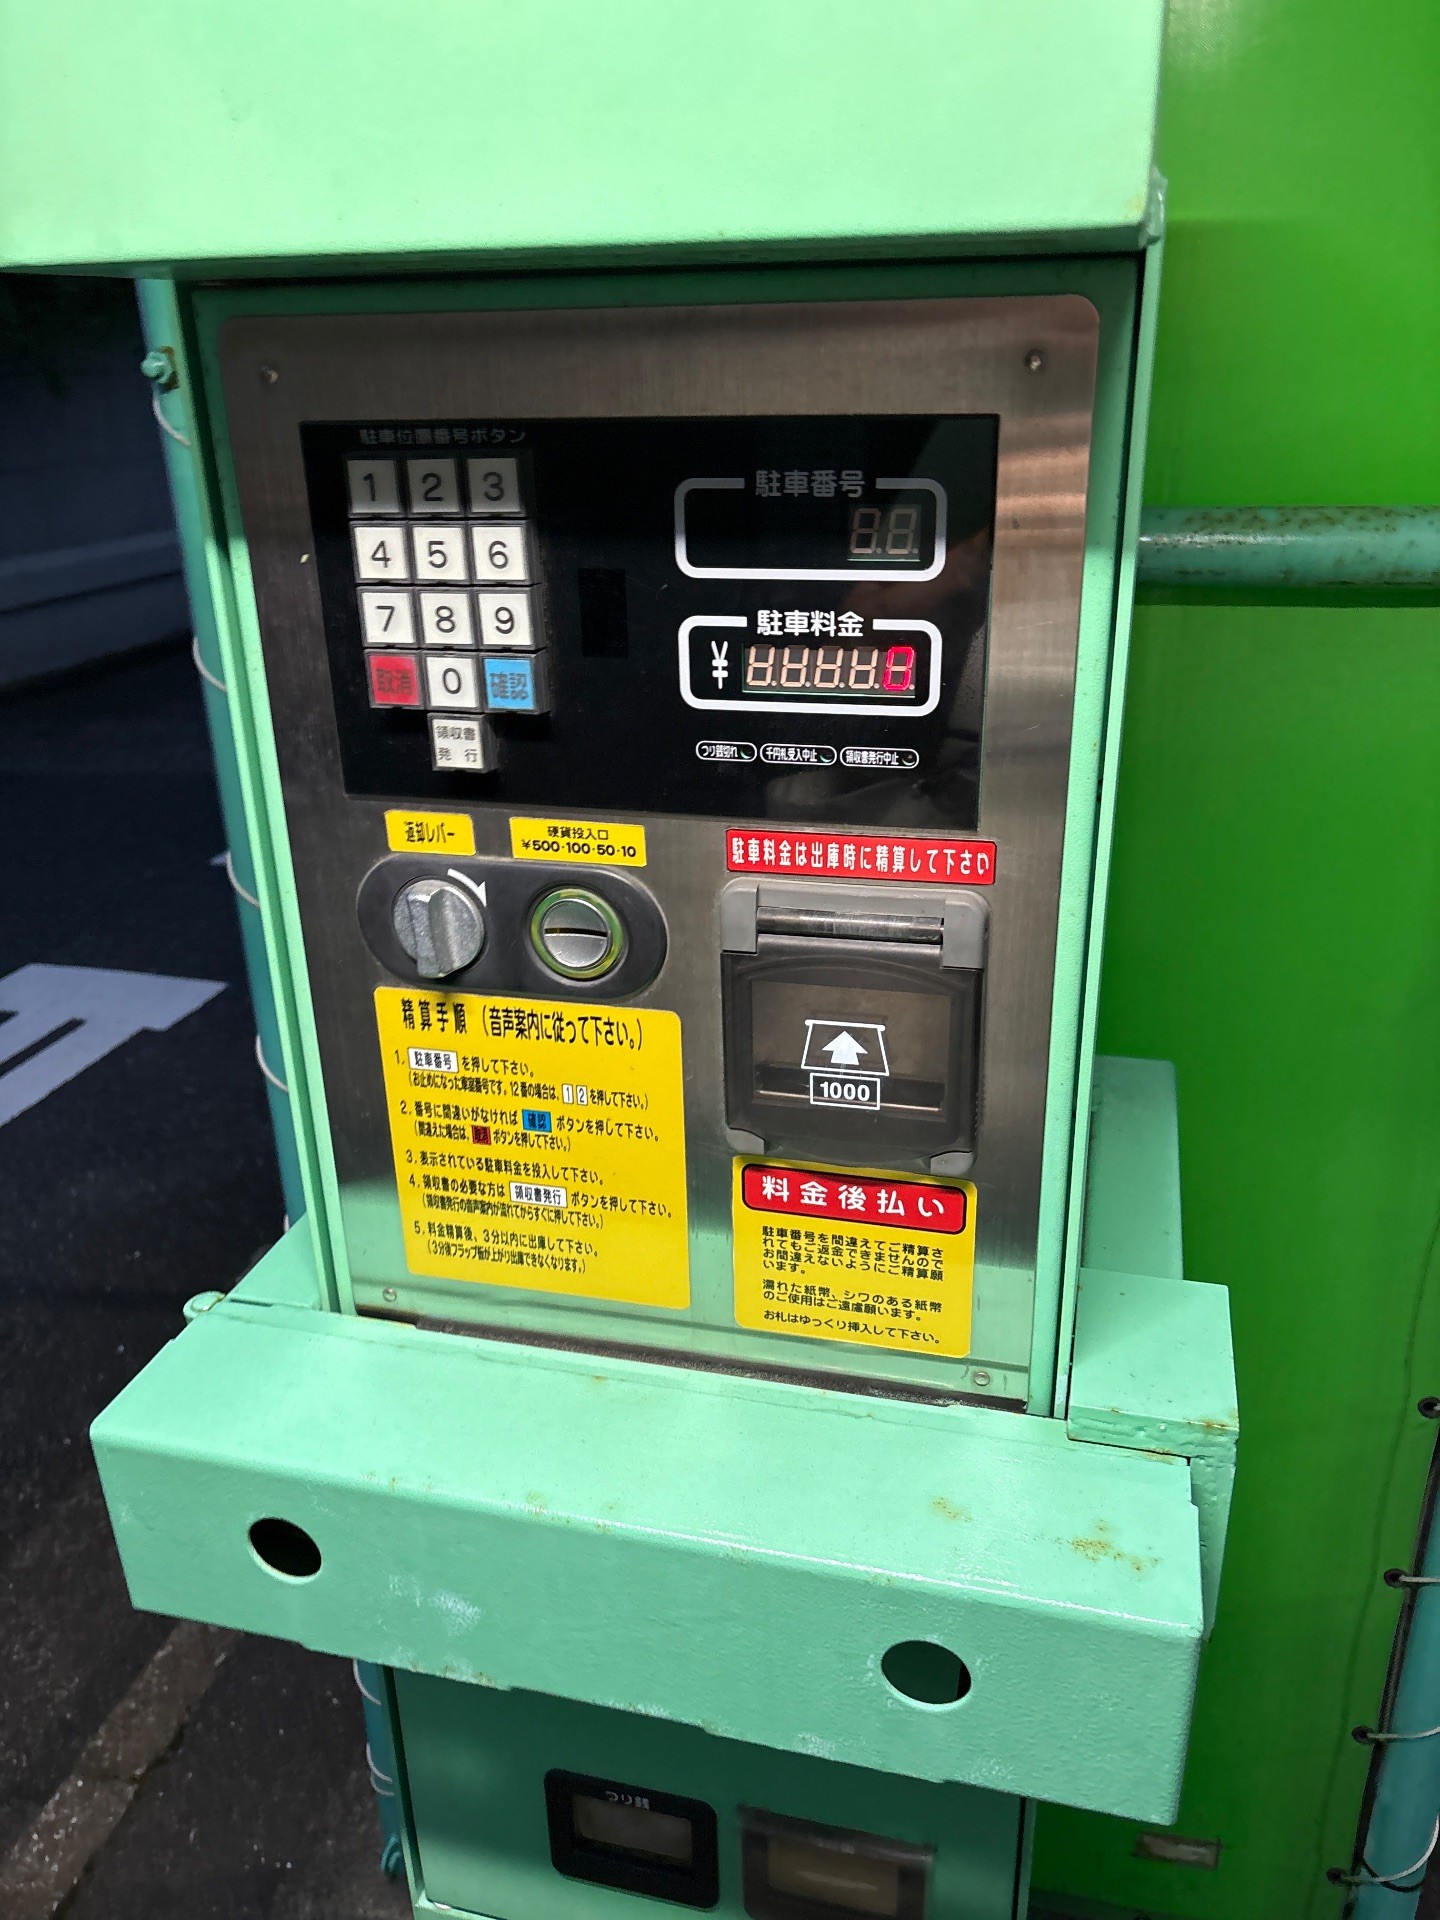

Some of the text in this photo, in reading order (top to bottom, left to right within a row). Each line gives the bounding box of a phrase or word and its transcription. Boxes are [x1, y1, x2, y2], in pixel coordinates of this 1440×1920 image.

[363, 473, 376, 502] 1
[421, 472, 444, 502] 2
[483, 471, 504, 501] 3
[755, 470, 866, 498] 駐車番号
[371, 540, 391, 568] 4
[427, 540, 447, 569] 5
[489, 540, 508, 569] 6
[376, 605, 395, 632] 7
[436, 605, 455, 633] 8
[495, 607, 515, 634] 9
[756, 610, 864, 637] 駐車料金
[376, 668, 413, 695] 取消
[443, 668, 462, 694] 0
[489, 672, 528, 700] 確認
[436, 726, 476, 741] 領収書
[701, 745, 738, 758] つり銭切れ
[765, 746, 818, 762] 千円札受入中止
[845, 750, 899, 766] 領収書発行中止
[405, 821, 456, 843] 返却レバー
[547, 825, 609, 841] 硬貨投入口
[731, 837, 989, 876] 駐車料金は出庫時に精算して下さい
[401, 997, 467, 1035] 精算手順
[414, 1051, 452, 1070] 駐車番号
[819, 1081, 870, 1102] 1000
[527, 1112, 547, 1130] 確認
[514, 1184, 562, 1206] 領収書発行
[762, 1175, 944, 1218] 料金後払い
[762, 1225, 944, 1259] 駐車番号を間違えてご精算さ
[762, 1237, 943, 1269] れてもご返金できませんので
[763, 1249, 943, 1282] お間違えないようにご精算願
[763, 1259, 806, 1275] います。
[763, 1278, 943, 1313] 濡れた紙幣、シワのある紙幣
[763, 1290, 921, 1322] のご使用はご遠慮願います。
[763, 1309, 940, 1344] お札はゆっくり挿入して下さい。
